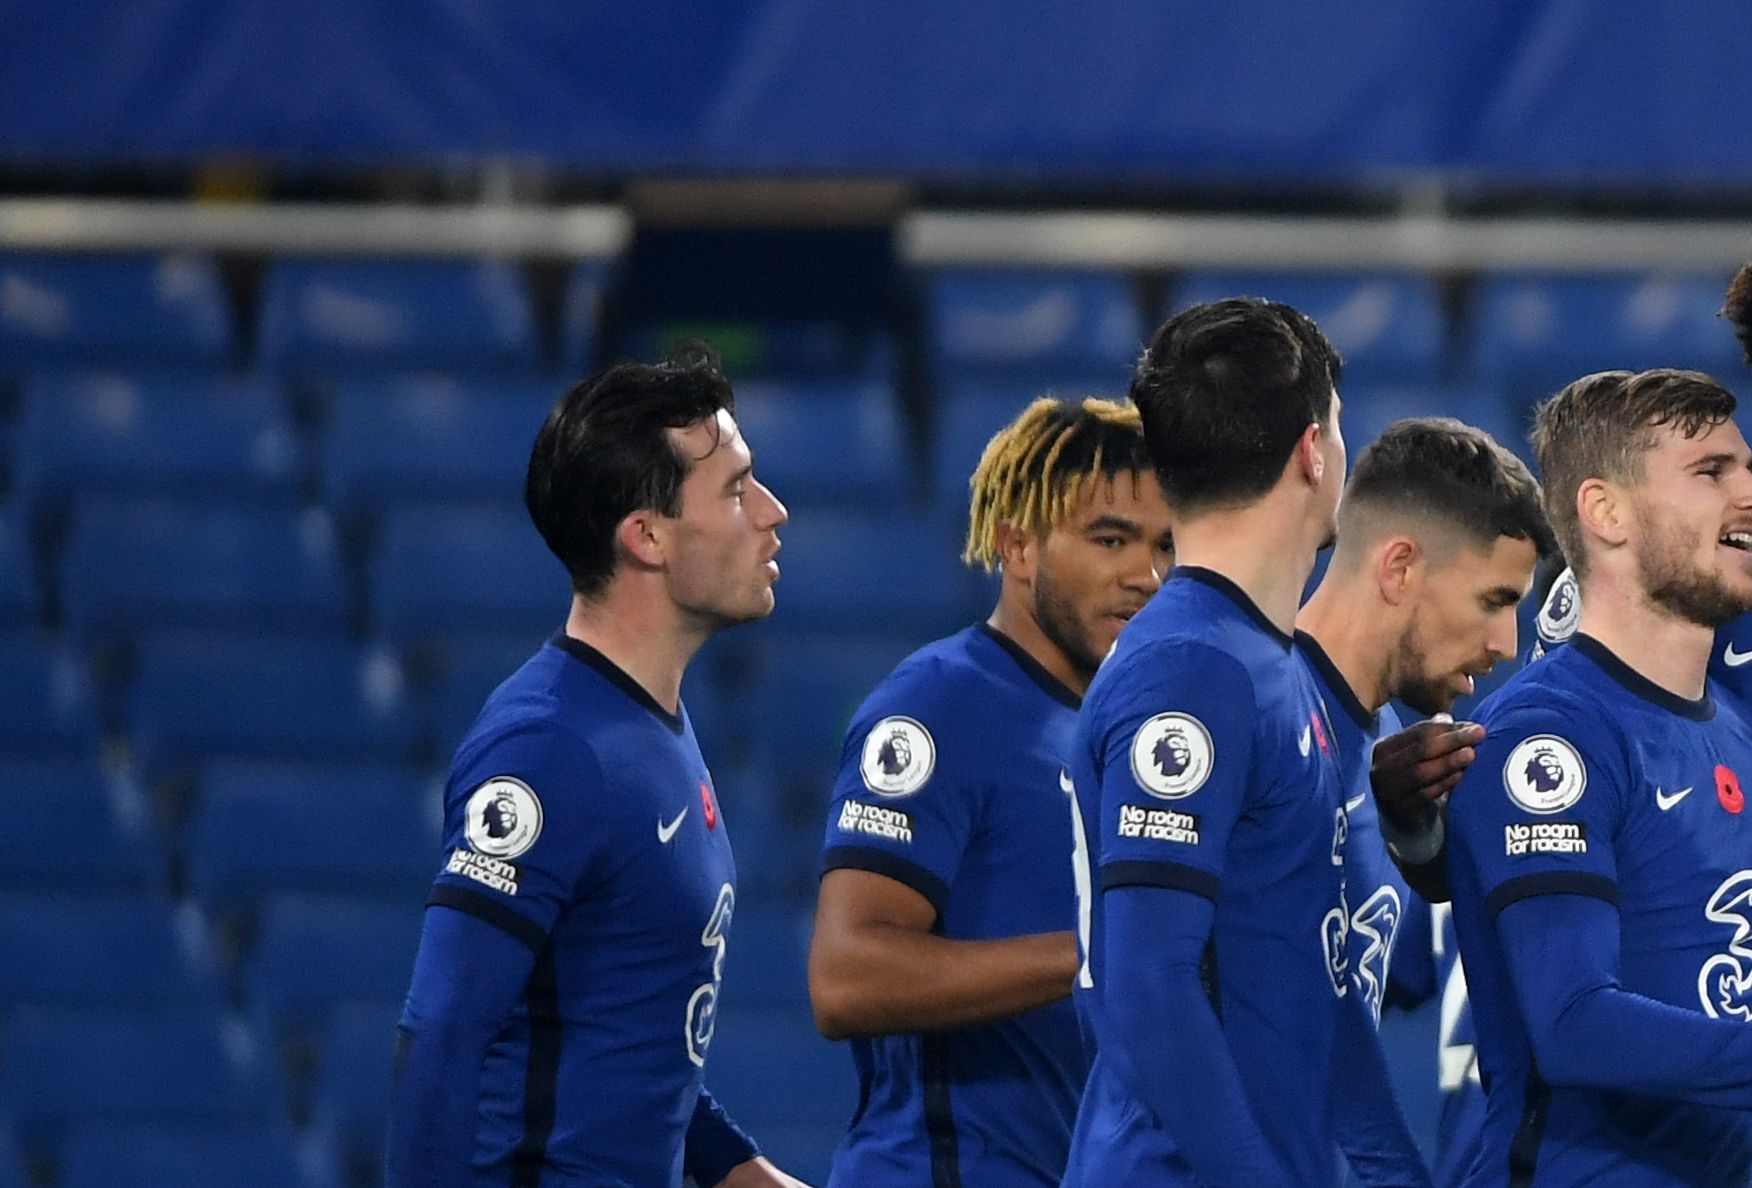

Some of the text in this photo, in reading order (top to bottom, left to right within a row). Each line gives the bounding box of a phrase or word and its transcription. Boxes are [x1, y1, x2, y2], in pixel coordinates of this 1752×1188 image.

[843, 800, 908, 826] No room
[1120, 805, 1194, 829] No room
[858, 818, 912, 844] racism
[1144, 825, 1198, 845] racism
[1505, 823, 1579, 839] No room
[1531, 838, 1587, 853] racism
[470, 852, 516, 879] room
[463, 866, 518, 896] racism
